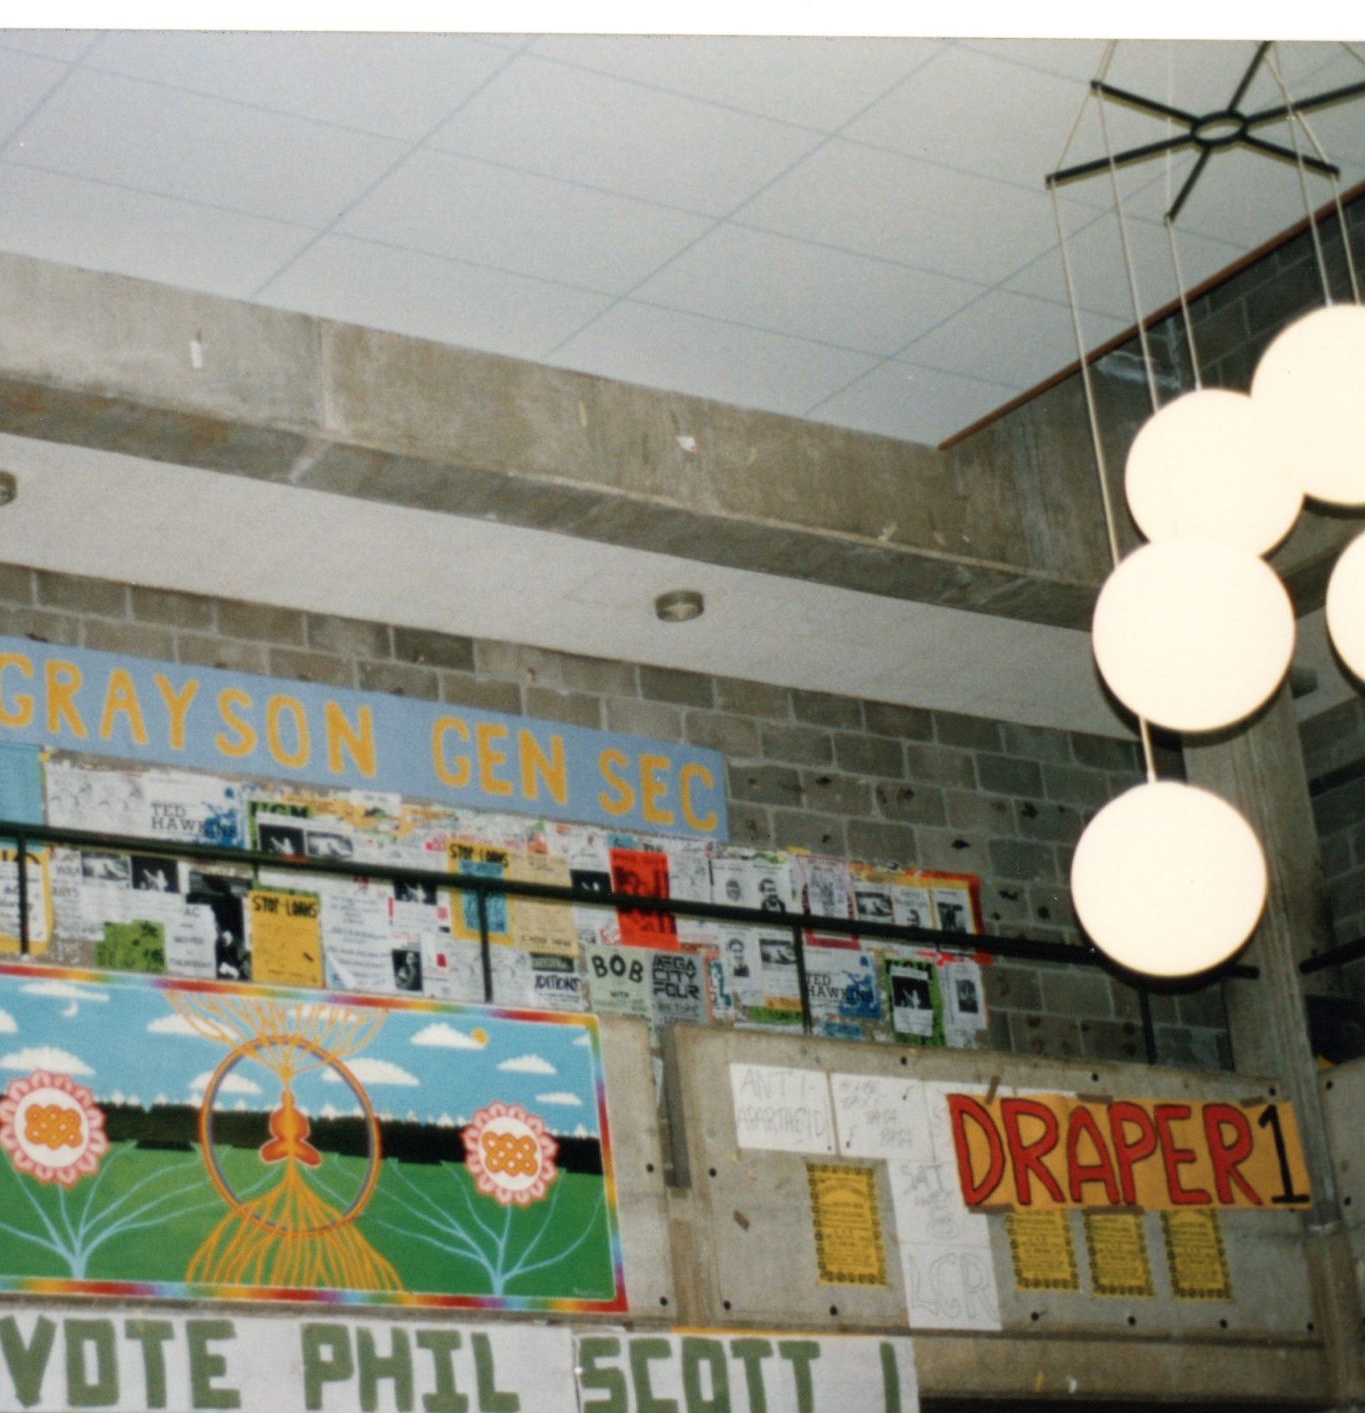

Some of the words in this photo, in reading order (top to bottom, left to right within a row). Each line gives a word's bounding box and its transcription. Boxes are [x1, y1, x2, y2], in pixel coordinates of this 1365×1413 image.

[431, 715, 567, 805] GEN
[598, 747, 718, 832] SEC
[150, 803, 187, 817] TED
[591, 955, 644, 983] BOB
[653, 968, 697, 983] CITY
[653, 981, 700, 1000] FOUR
[736, 1106, 827, 1137] APARTHEID
[908, 1253, 1002, 1323] LCR
